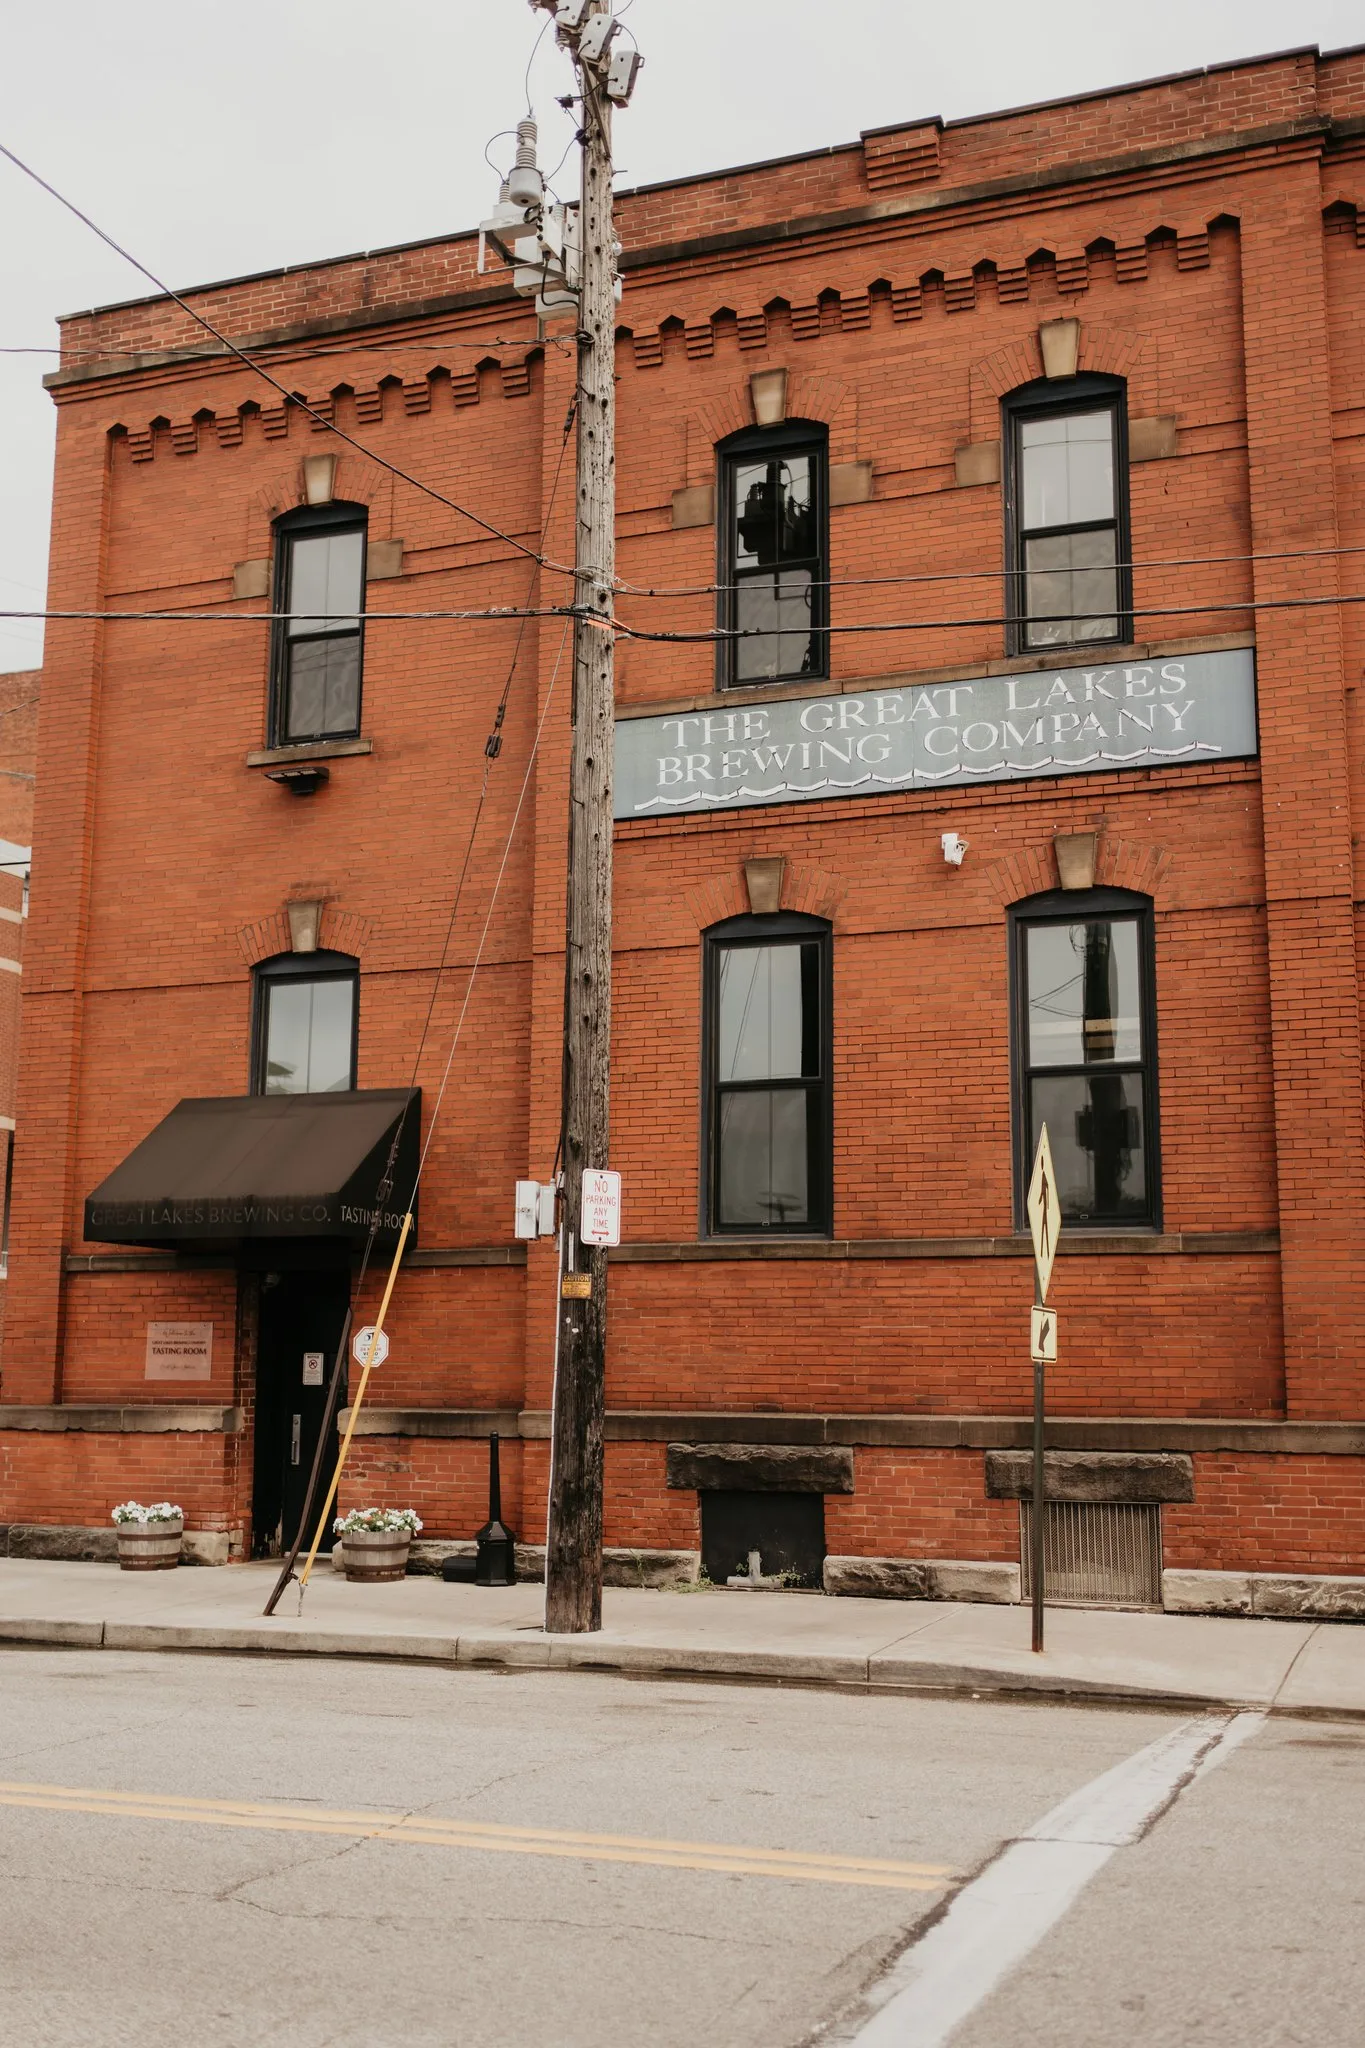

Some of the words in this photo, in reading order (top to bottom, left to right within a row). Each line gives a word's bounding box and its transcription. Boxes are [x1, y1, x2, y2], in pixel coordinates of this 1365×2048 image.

[662, 710, 771, 749] THE
[800, 685, 973, 733] GREAT
[1004, 663, 1187, 711] LAKES
[656, 733, 893, 786] BREWING
[923, 700, 1196, 756] COMPANY
[594, 1180, 609, 1194] NO
[585, 1196, 617, 1207] PARKING
[92, 1205, 145, 1226] GREAT
[151, 1204, 204, 1225] LAKES
[209, 1204, 294, 1224] BREWING
[300, 1204, 331, 1224] CO.
[593, 1208, 608, 1217] ANY
[593, 1219, 609, 1229] TIME
[152, 1347, 182, 1355] TASTING
[183, 1347, 207, 1355] ROOM
